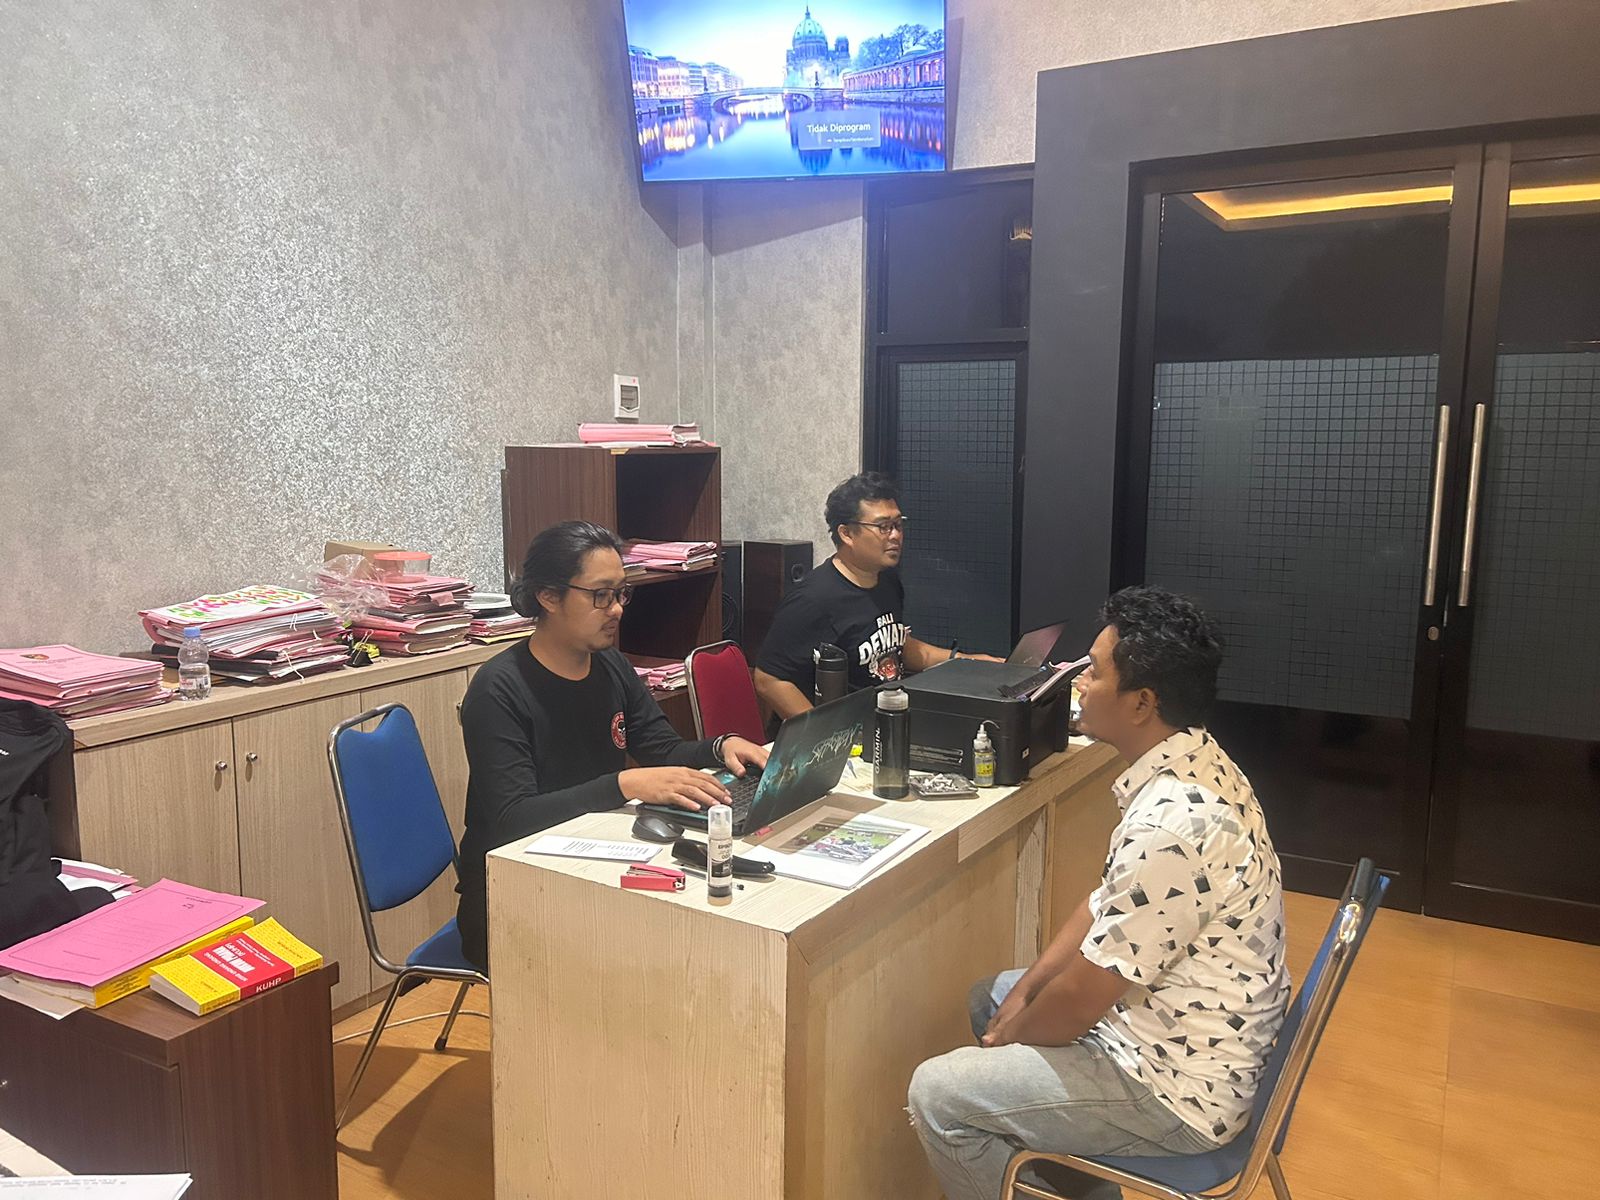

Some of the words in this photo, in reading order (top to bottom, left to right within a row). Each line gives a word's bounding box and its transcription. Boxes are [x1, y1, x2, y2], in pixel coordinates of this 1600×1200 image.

[807, 123, 828, 133] Tidak
[830, 123, 871, 134] Diprogram
[876, 613, 894, 628] BALI
[858, 623, 908, 666] DEWAT
[255, 977, 282, 993] KUHP
